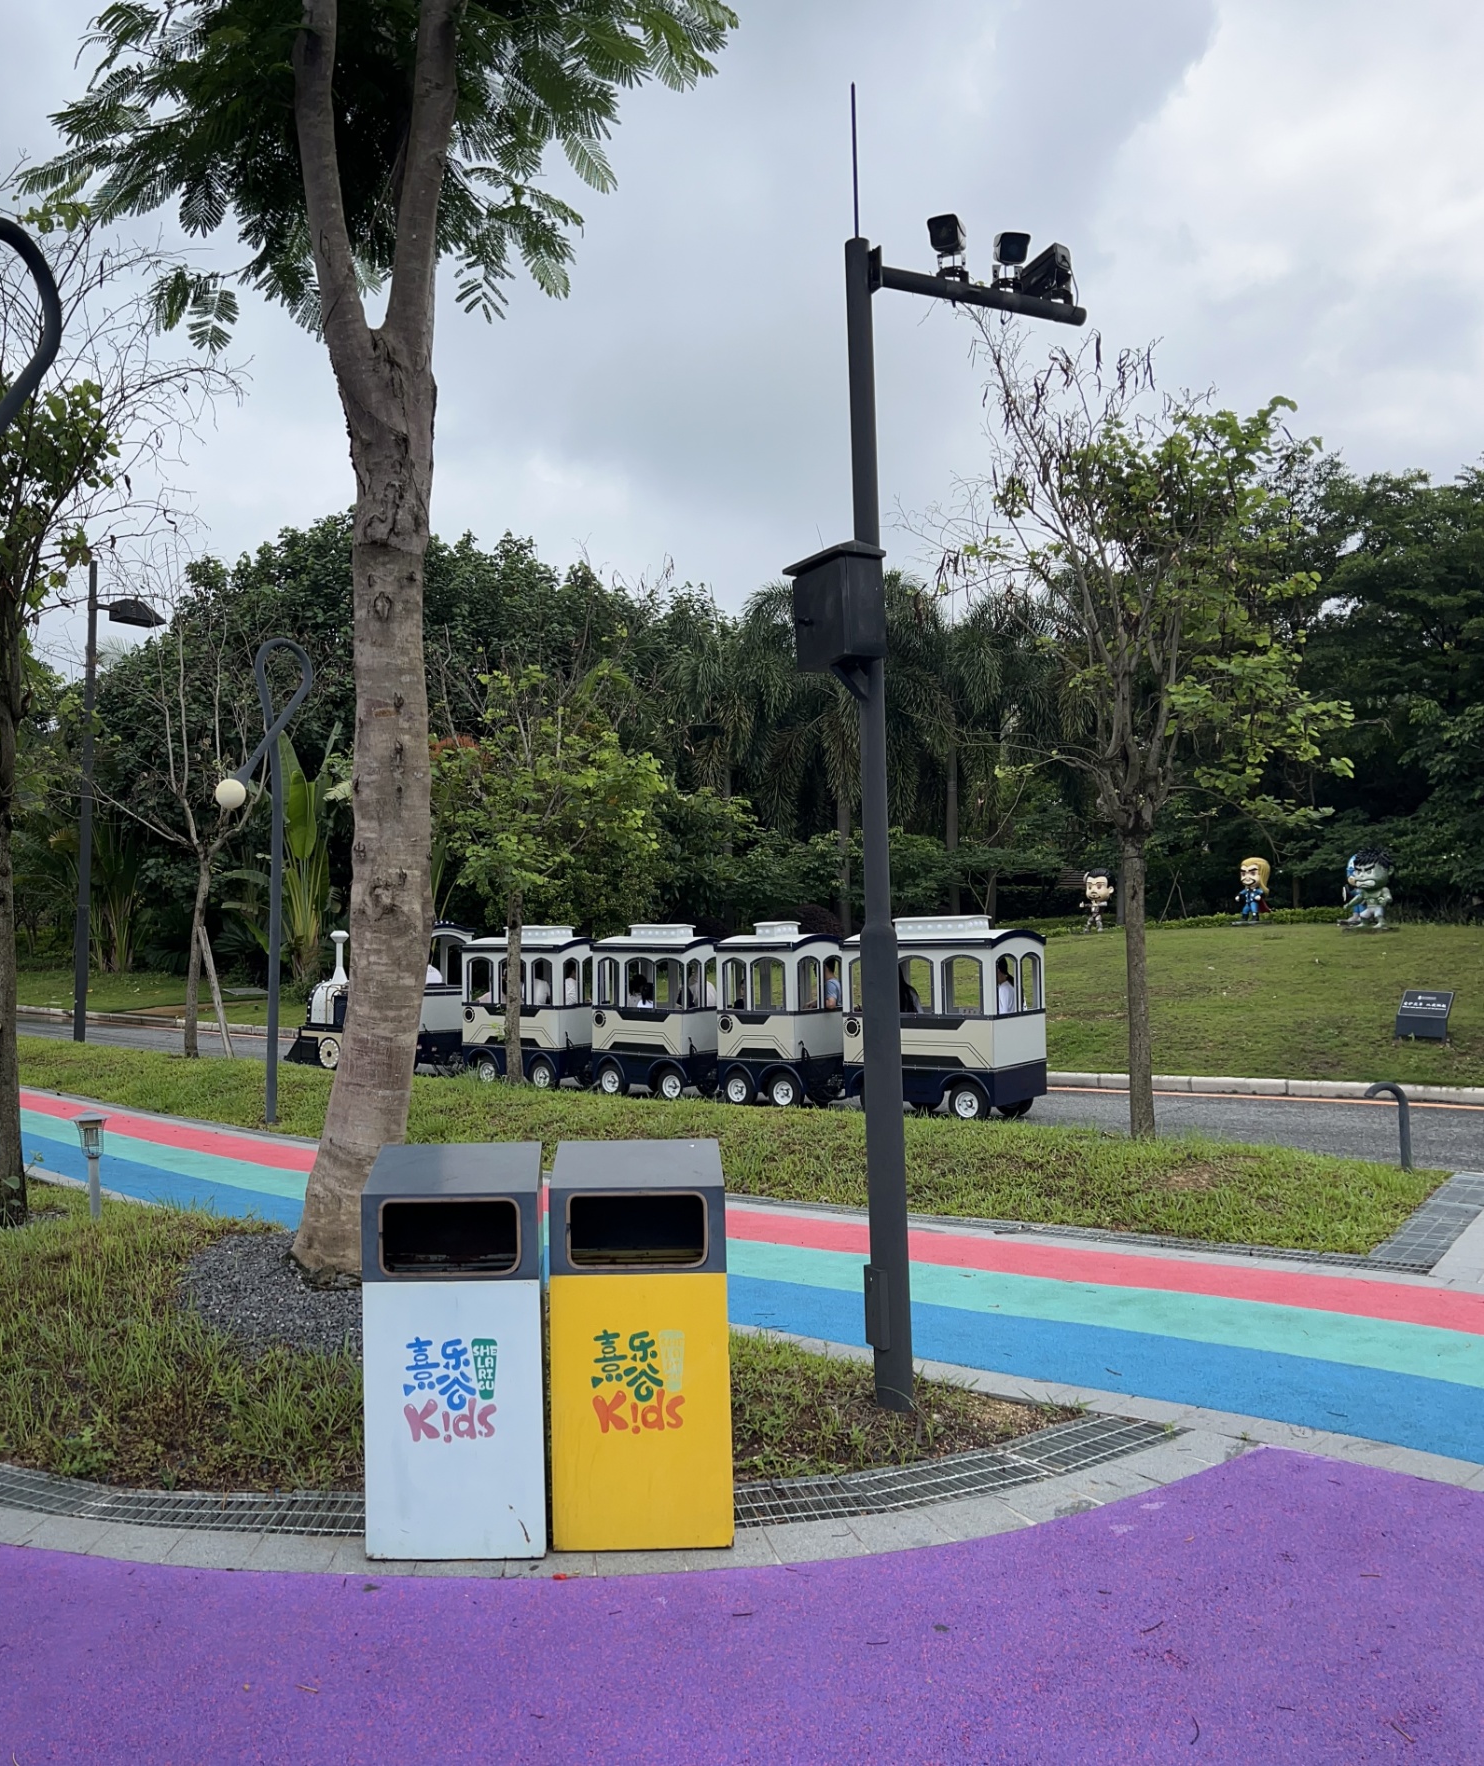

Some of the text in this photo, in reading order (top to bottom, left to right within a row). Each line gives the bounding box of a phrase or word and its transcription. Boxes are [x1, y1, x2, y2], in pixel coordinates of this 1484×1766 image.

[472, 1345, 497, 1356] SHE
[476, 1357, 494, 1368] LA
[478, 1369, 493, 1380] RI
